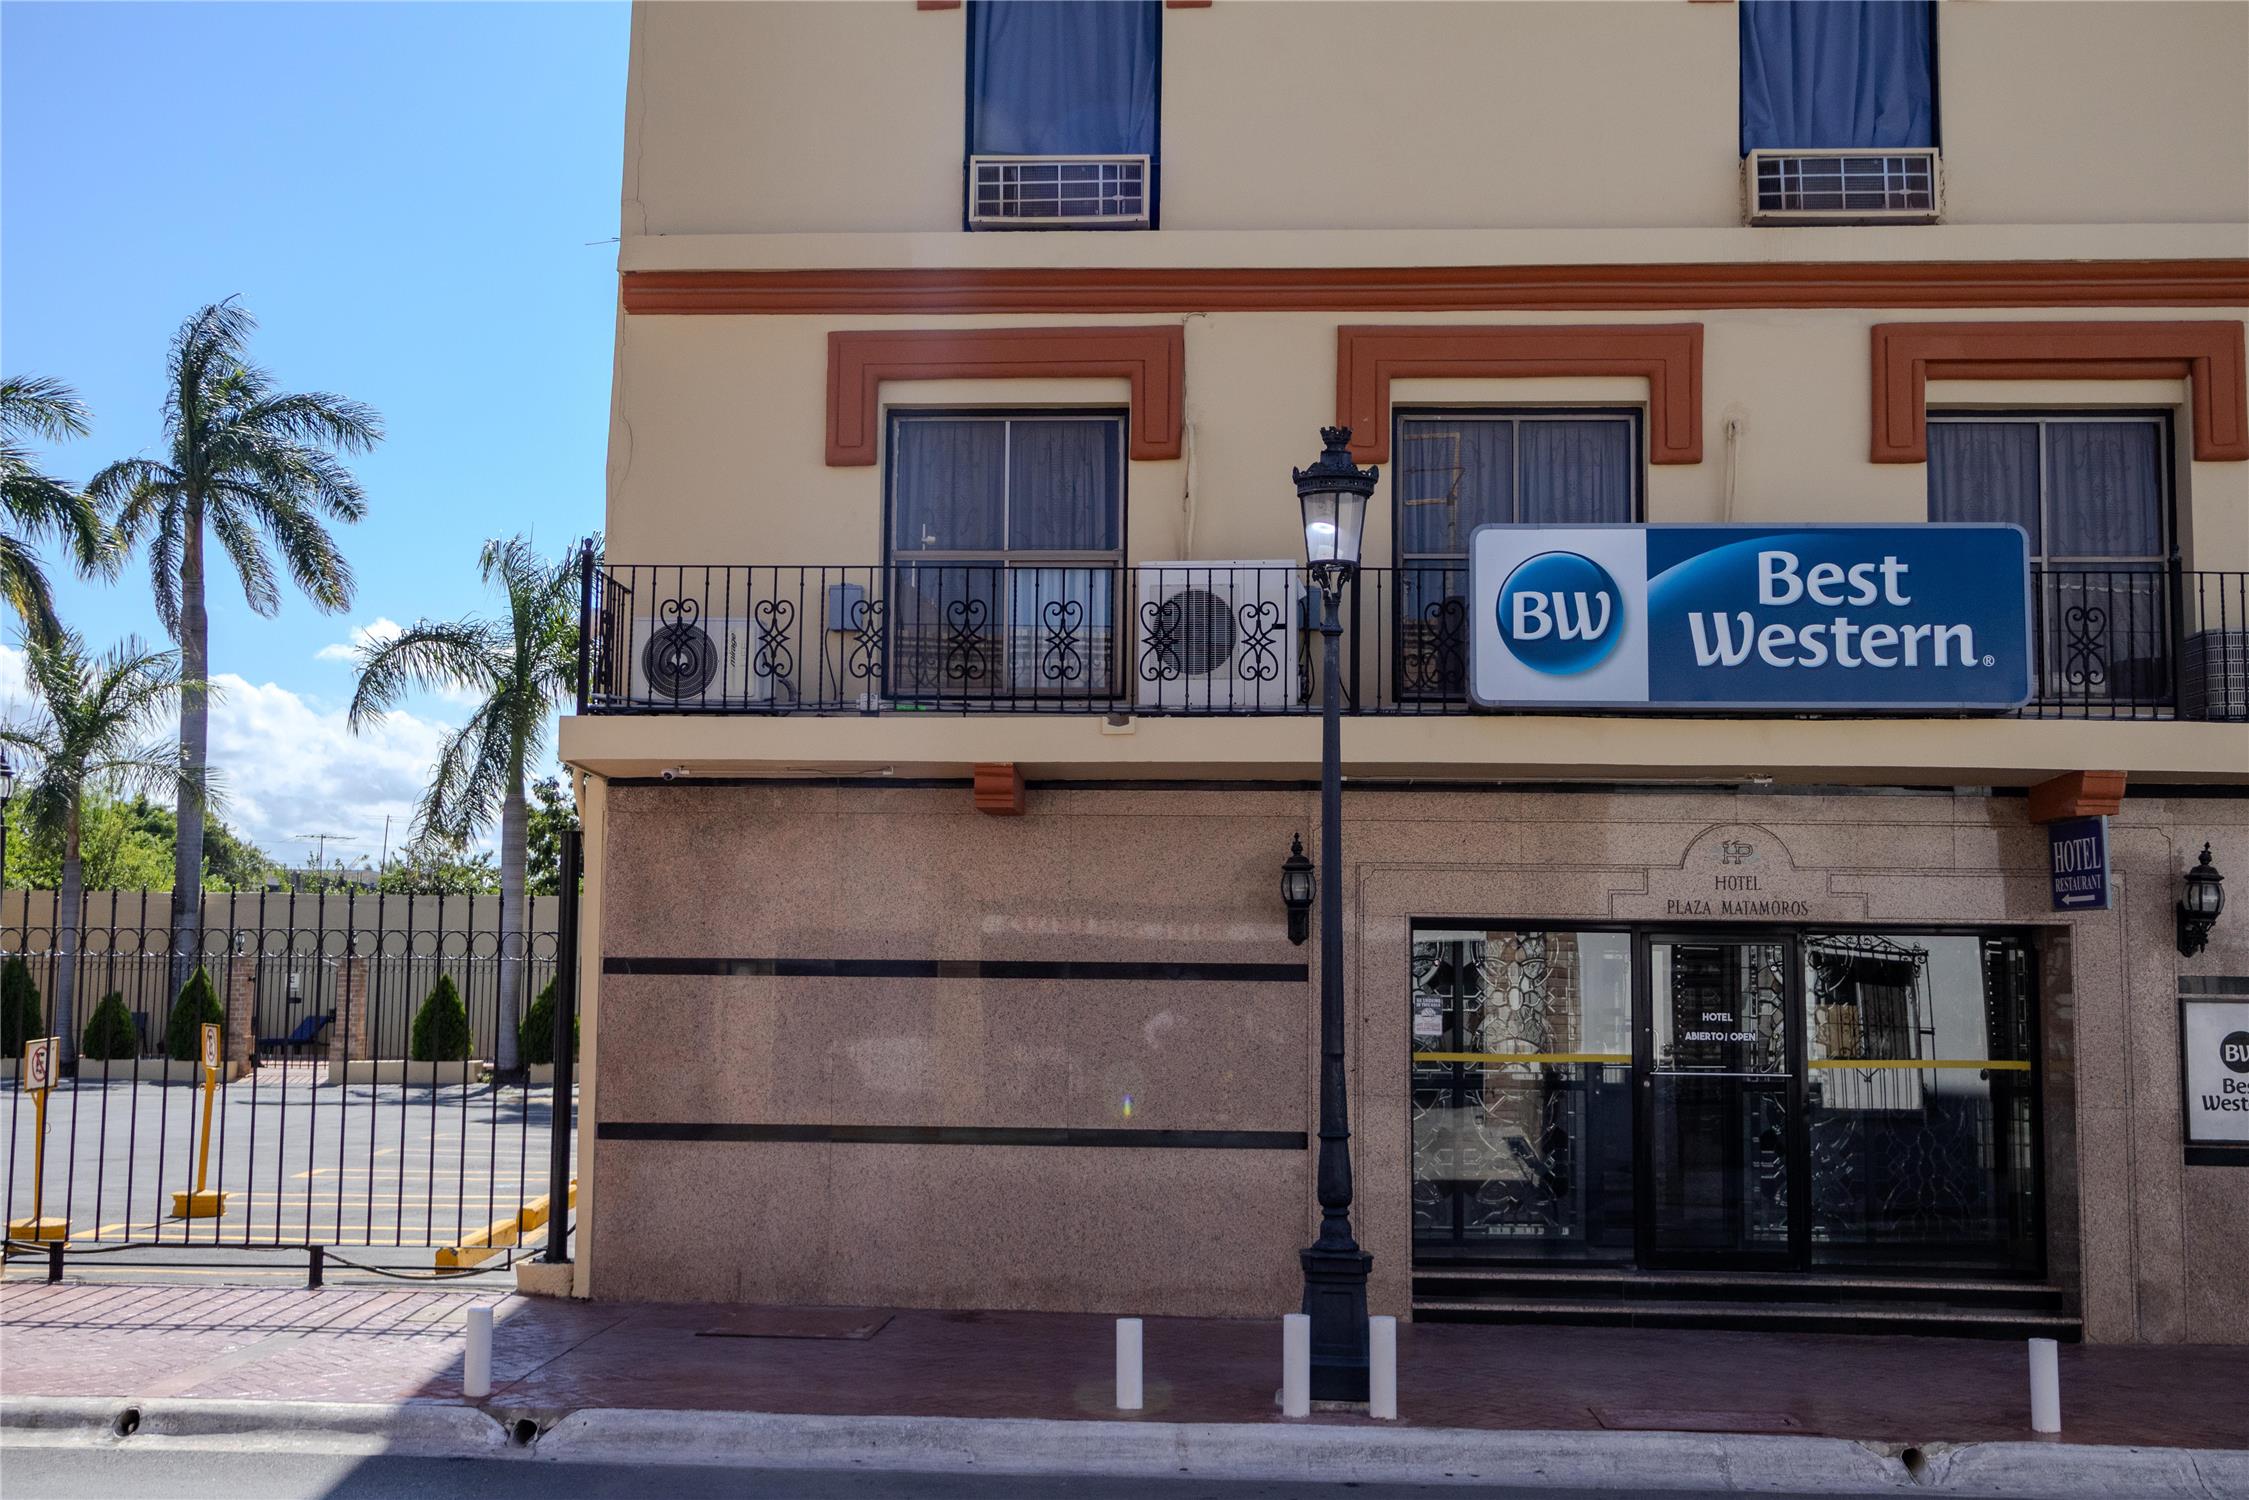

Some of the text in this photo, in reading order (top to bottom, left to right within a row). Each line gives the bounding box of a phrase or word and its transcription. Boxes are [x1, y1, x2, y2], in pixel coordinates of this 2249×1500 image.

[1758, 550, 1911, 606] Best
[1512, 590, 1611, 641] BW
[1688, 610, 1978, 668] Western
[2054, 837, 2101, 873] HOTEL
[1715, 875, 1762, 891] HOTEL
[2055, 873, 2101, 893] RESTAURANT
[1667, 899, 1809, 916] PLAZA MATAMOROS
[1702, 1012, 1733, 1022] HOTEL
[1730, 1032, 1756, 1041] OPEN
[2202, 1095, 2249, 1111] West
